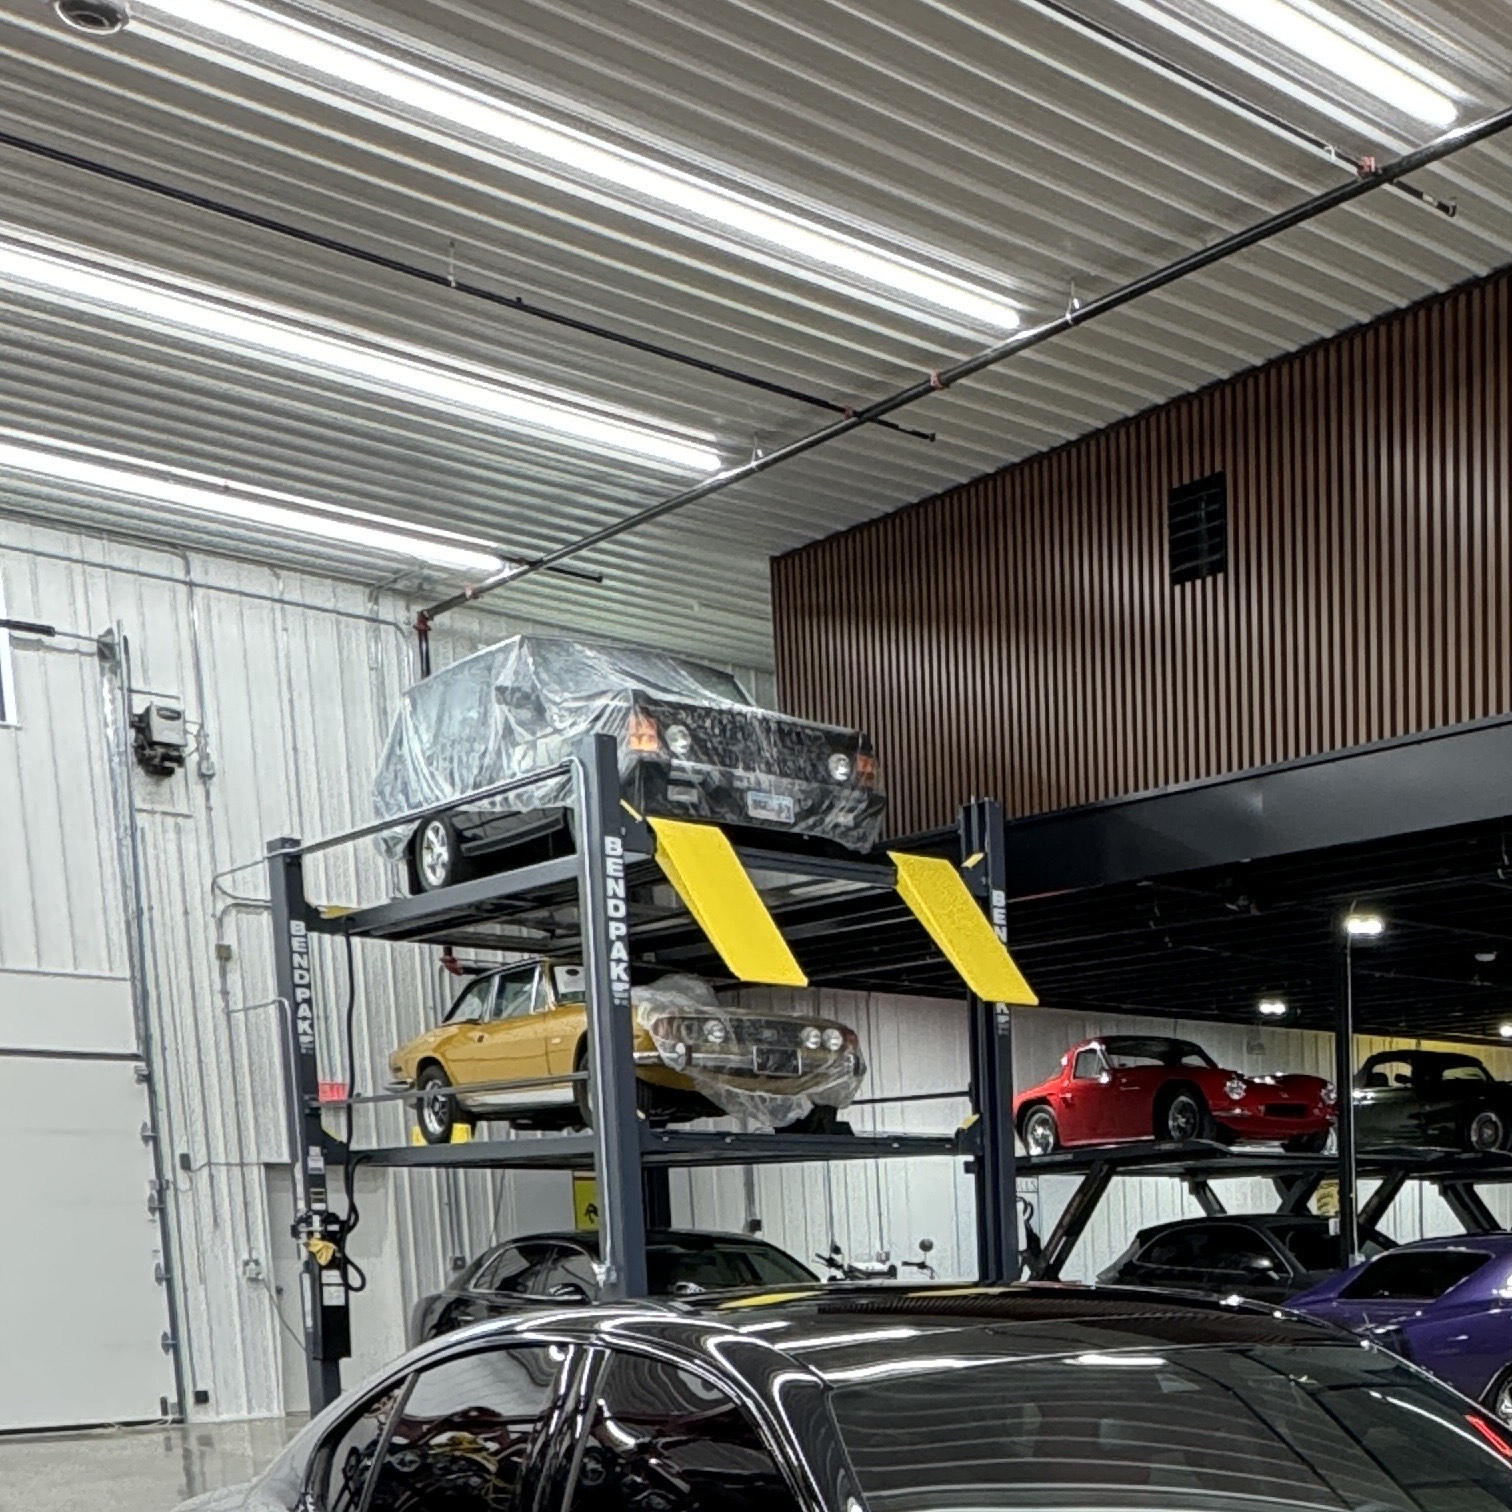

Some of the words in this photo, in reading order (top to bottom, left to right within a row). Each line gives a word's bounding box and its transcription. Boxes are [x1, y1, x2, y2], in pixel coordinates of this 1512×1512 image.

[604, 836, 630, 982] BENDPAK
[992, 889, 1009, 1014] BENK
[290, 920, 313, 1034] BENDPAK
